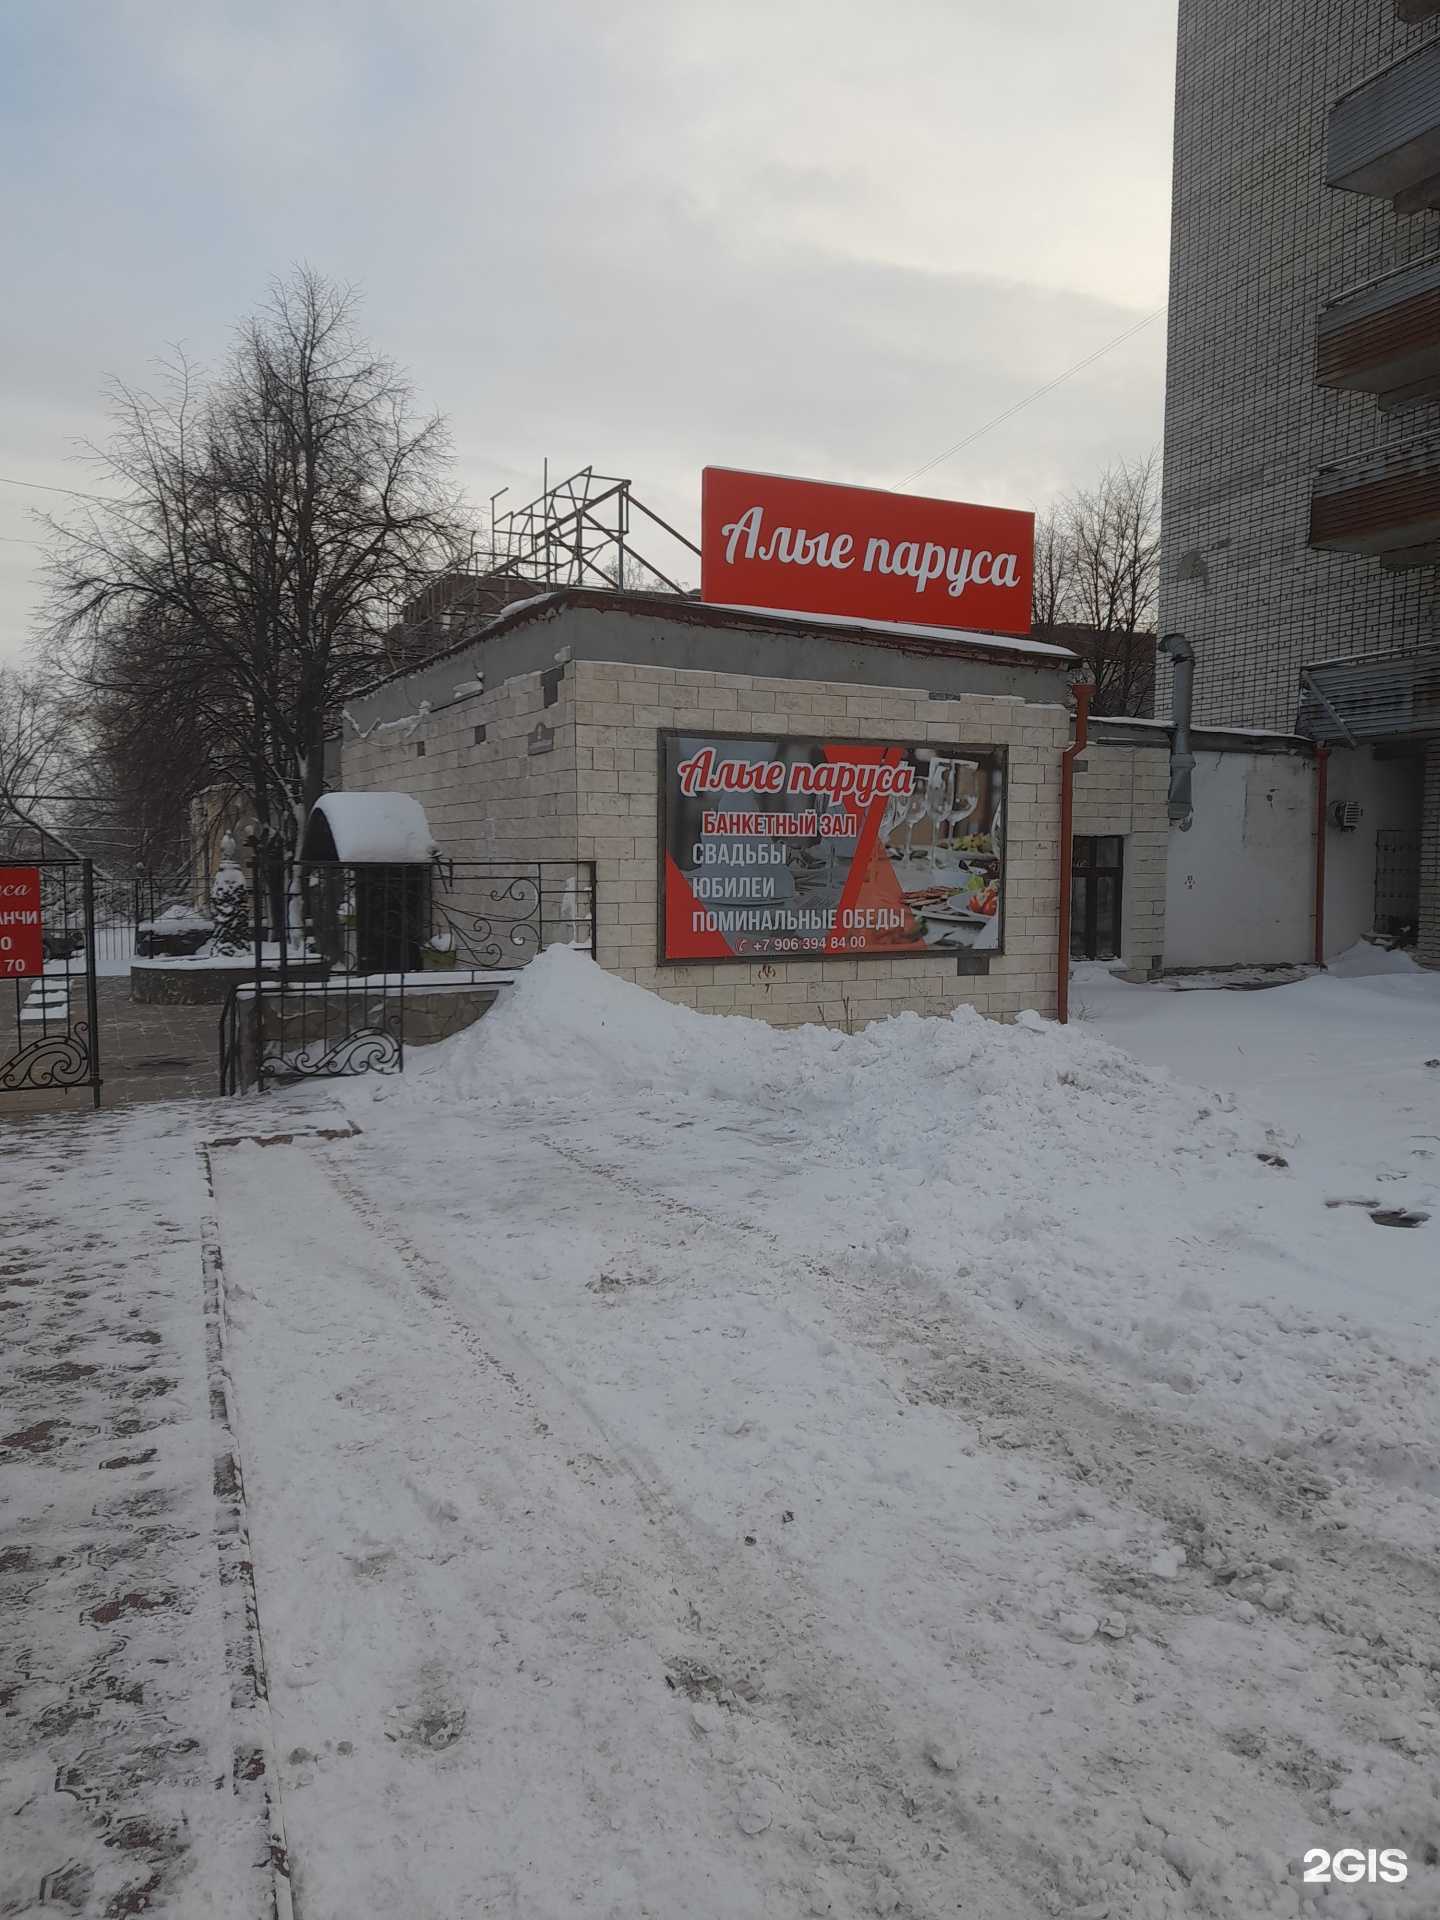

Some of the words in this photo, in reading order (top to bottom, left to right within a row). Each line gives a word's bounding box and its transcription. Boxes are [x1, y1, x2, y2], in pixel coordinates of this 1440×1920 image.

[721, 506, 855, 569] Алые
[863, 537, 1021, 597] паруса
[678, 747, 786, 796] Алые
[787, 761, 916, 807] паруса
[702, 809, 817, 837] БАНКЕТНЫЙ
[820, 814, 857, 837] ЗАЛ
[692, 843, 787, 866] СВАДЬБЫ
[692, 877, 775, 898] ЮБИЛЕИ
[692, 910, 837, 933] ПОМИНАЛЬНЫЕ
[842, 908, 905, 931] ОБЕДЫ
[753, 940, 770, 951] +7
[774, 939, 799, 950] 906
[802, 938, 827, 949] 394
[831, 937, 846, 949] 84
[850, 936, 866, 948] 00
